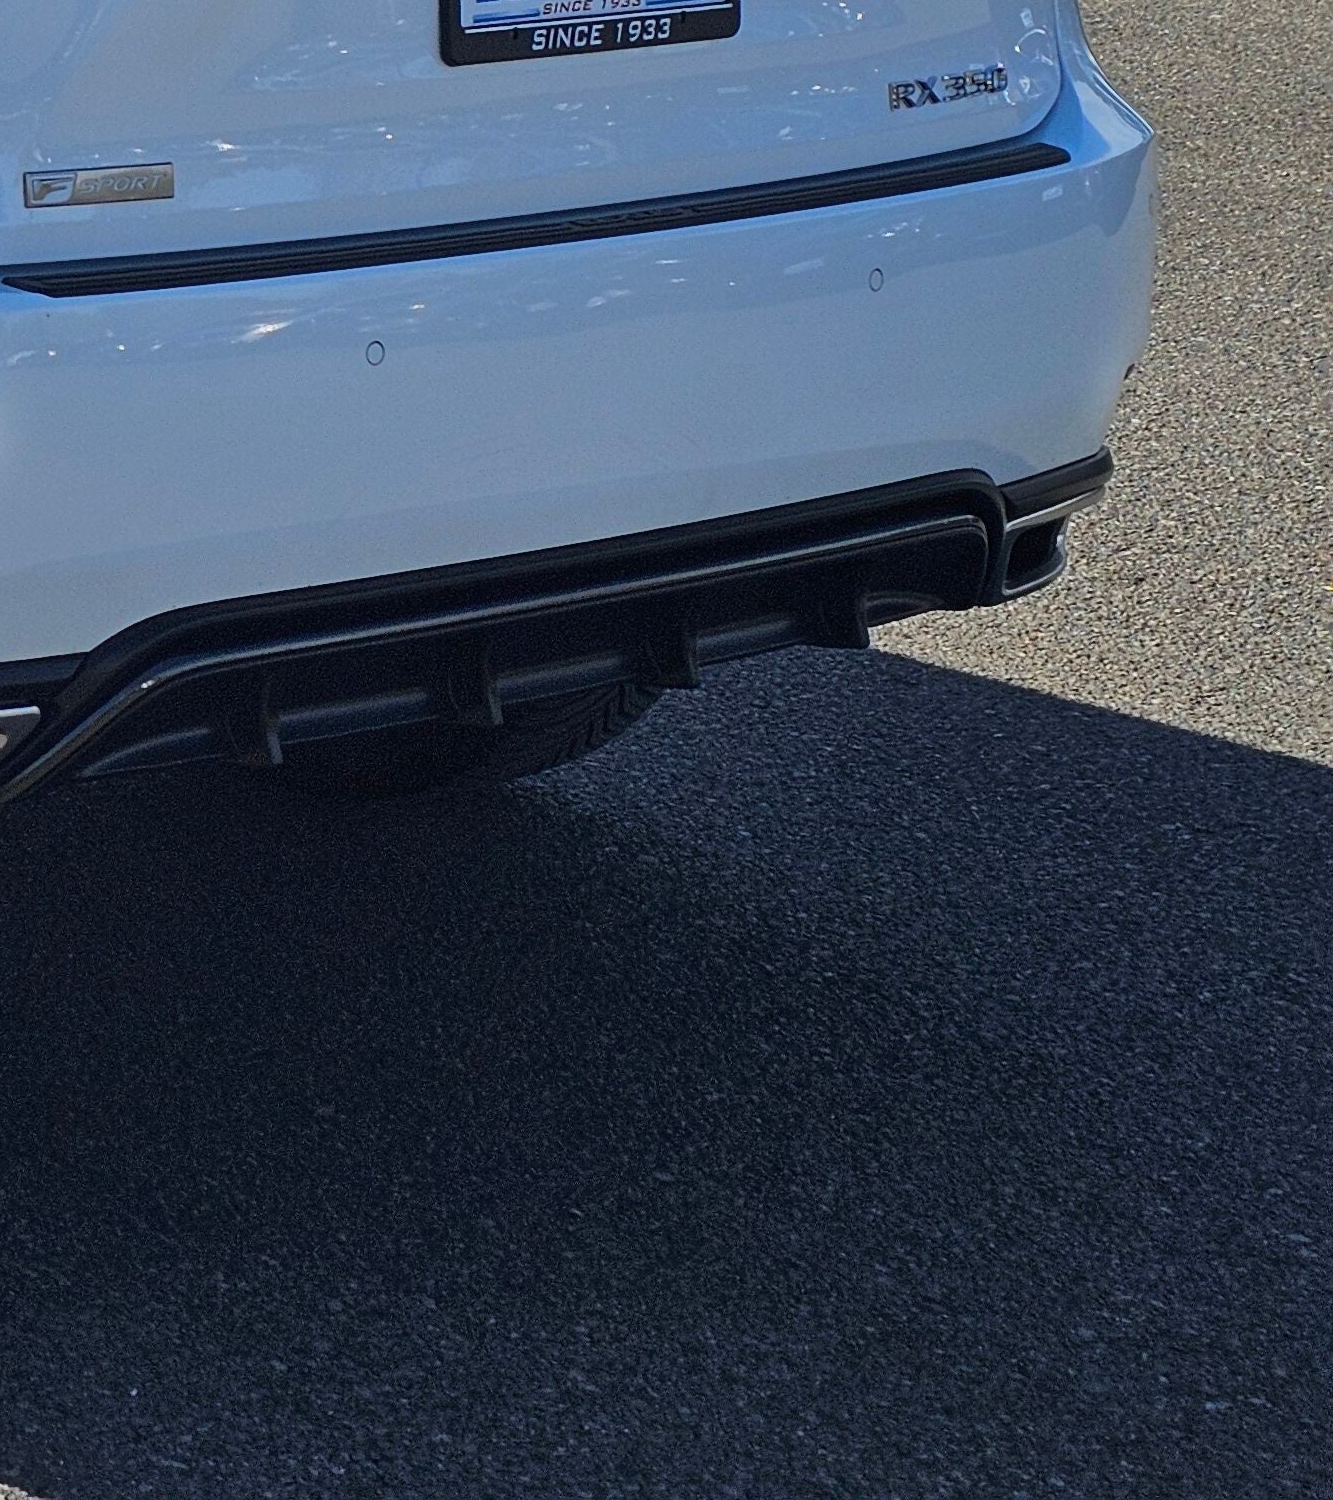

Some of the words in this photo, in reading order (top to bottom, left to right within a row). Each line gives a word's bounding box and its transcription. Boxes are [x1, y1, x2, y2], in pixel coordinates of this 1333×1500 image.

[542, 0, 592, 16] SINCE
[532, 23, 602, 50] SINCE
[616, 18, 671, 44] 1933
[79, 174, 167, 194] SPORT
